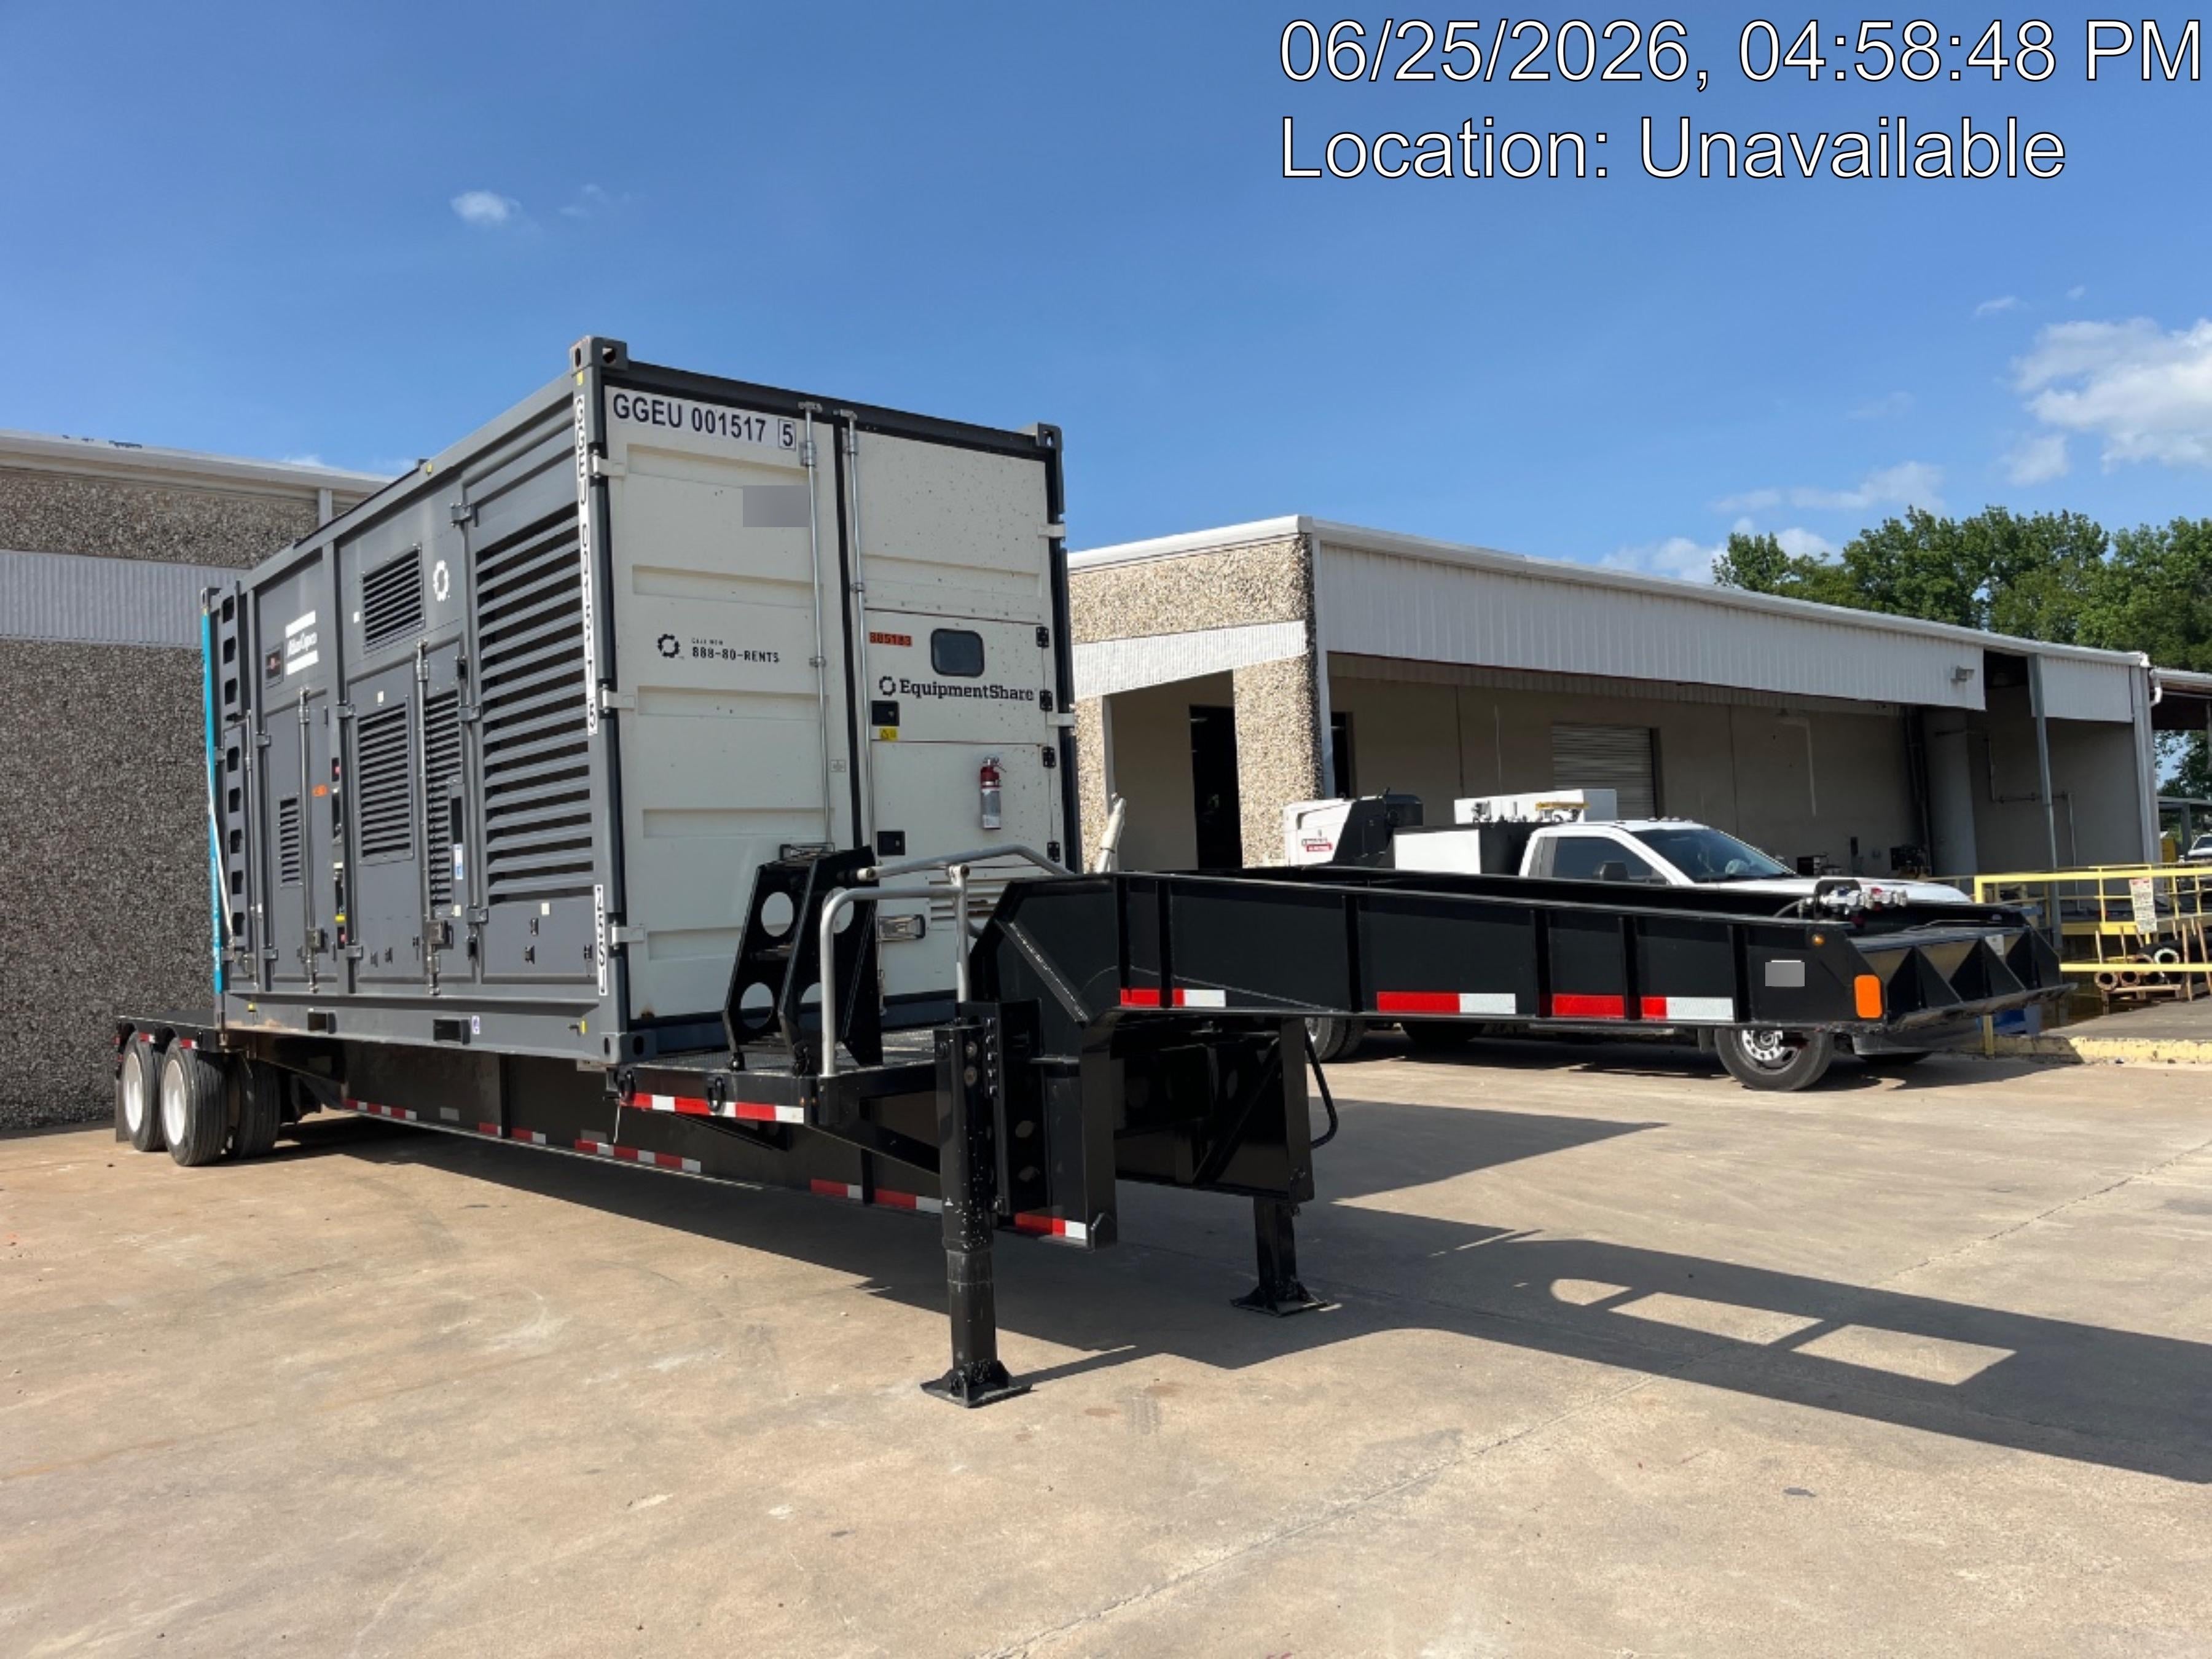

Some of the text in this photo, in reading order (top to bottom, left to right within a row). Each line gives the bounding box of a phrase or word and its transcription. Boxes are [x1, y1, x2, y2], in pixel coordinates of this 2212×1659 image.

[613, 393, 794, 447] GGEU 001517 5
[692, 646, 780, 664] 888-80-RENTS
[899, 677, 1035, 701] EquipmentShare
